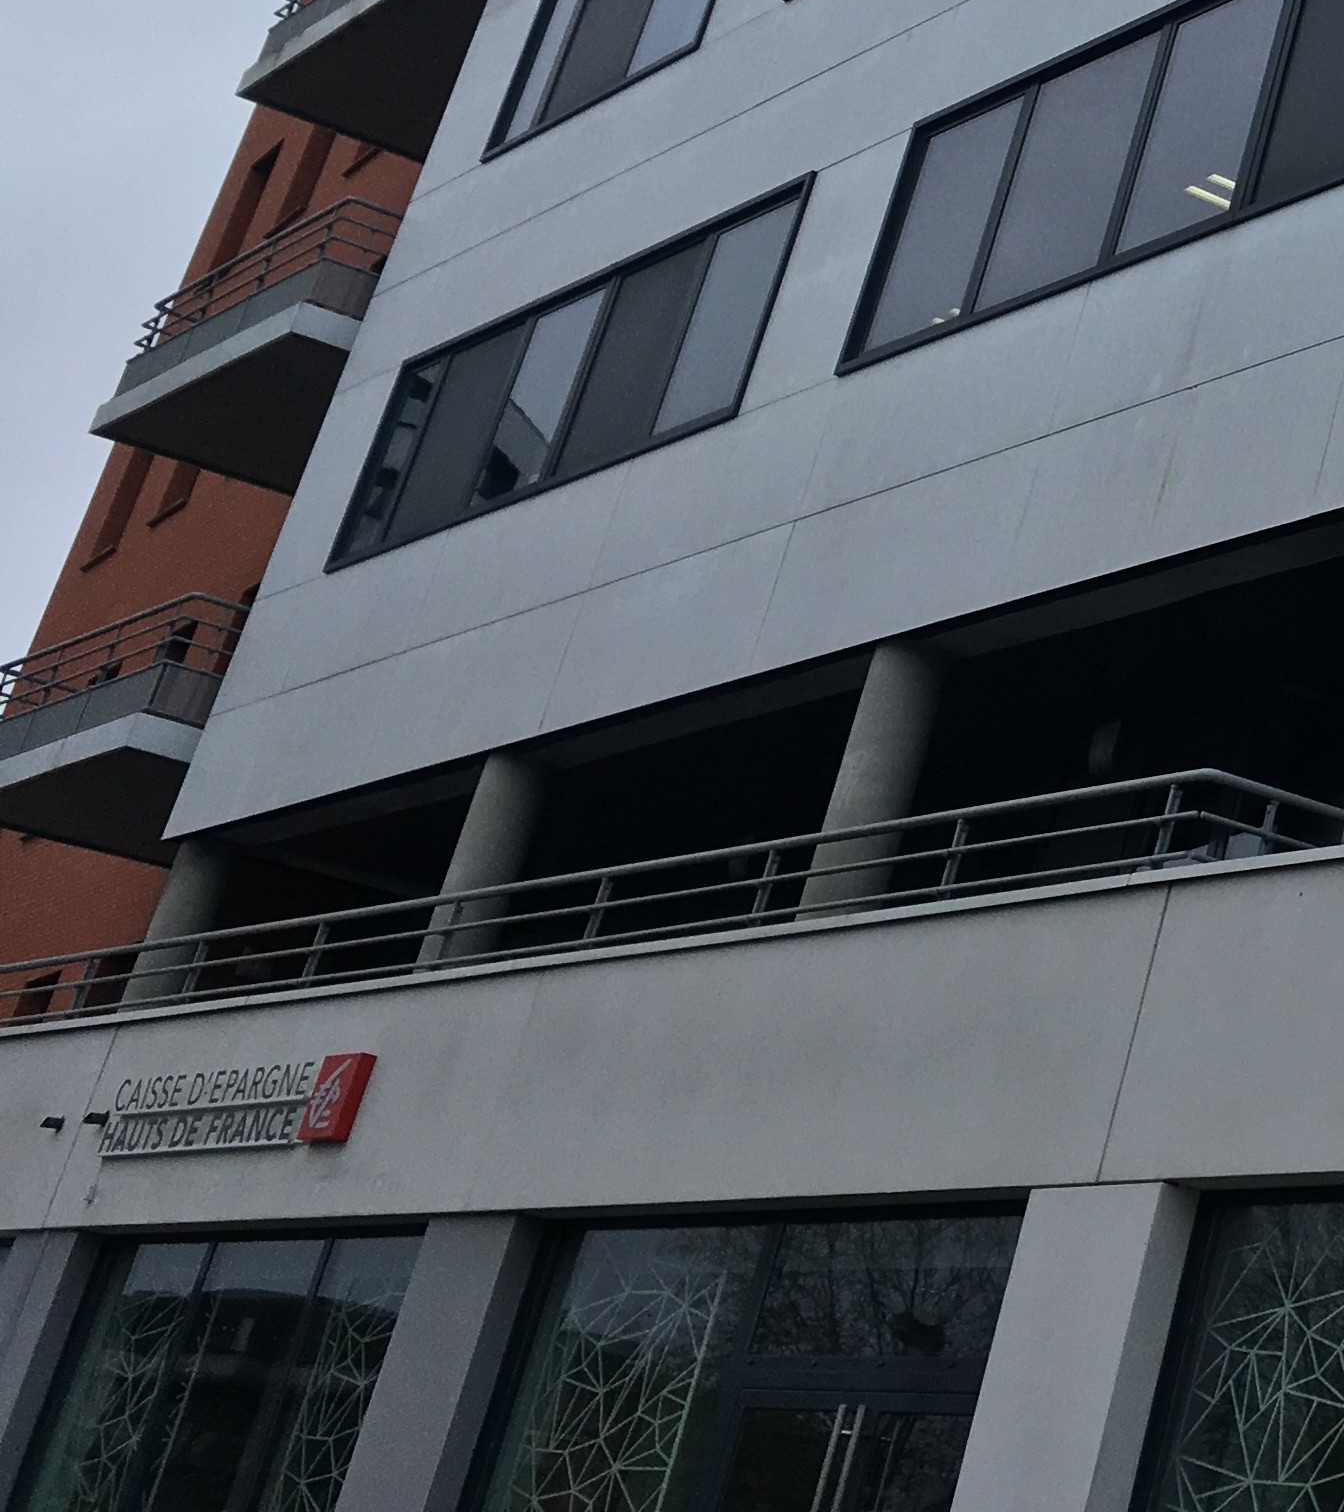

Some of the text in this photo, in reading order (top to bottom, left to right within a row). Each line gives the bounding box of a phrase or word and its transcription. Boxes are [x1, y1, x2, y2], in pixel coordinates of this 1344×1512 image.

[115, 1061, 316, 1112] CAISSE D'EPARGNE
[97, 1106, 299, 1154] HAUTS DE FRANCE
